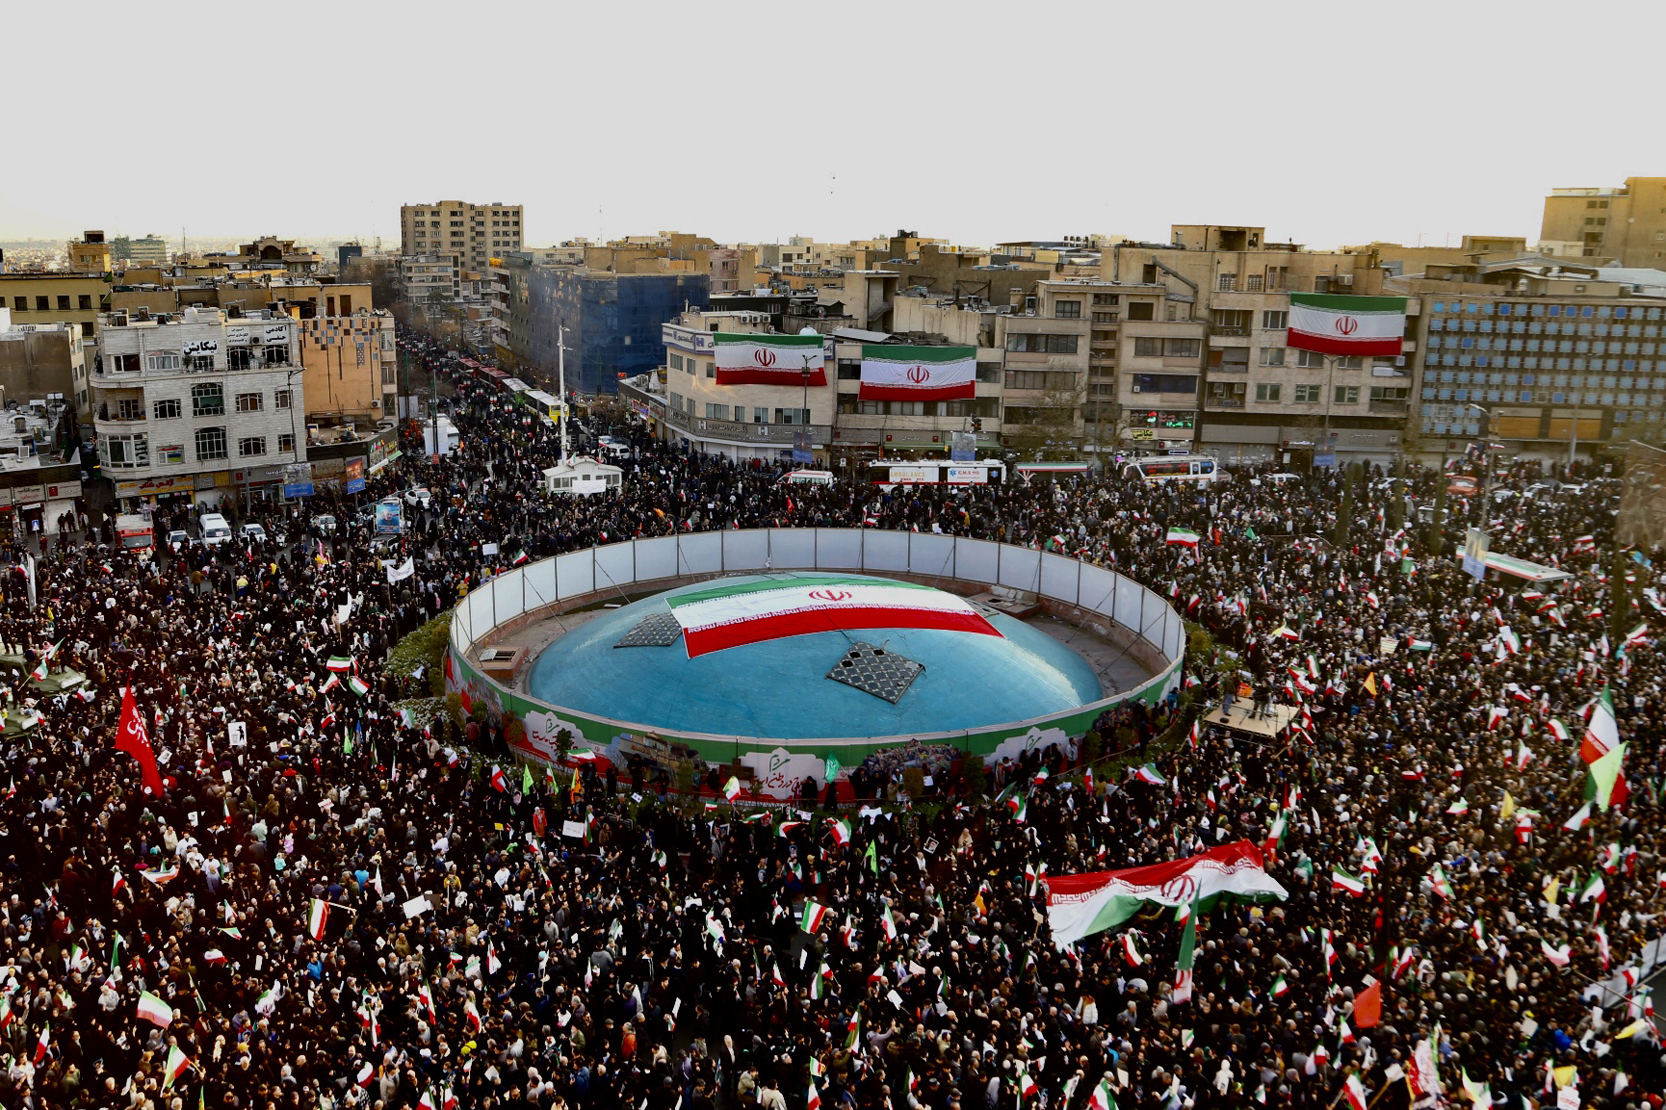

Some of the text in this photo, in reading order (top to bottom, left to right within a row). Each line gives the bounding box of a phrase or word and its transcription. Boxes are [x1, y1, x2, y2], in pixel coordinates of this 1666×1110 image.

[1132, 429, 1153, 439] عکاسی
[545, 717, 561, 734] مردم
[768, 754, 791, 773] مردم
